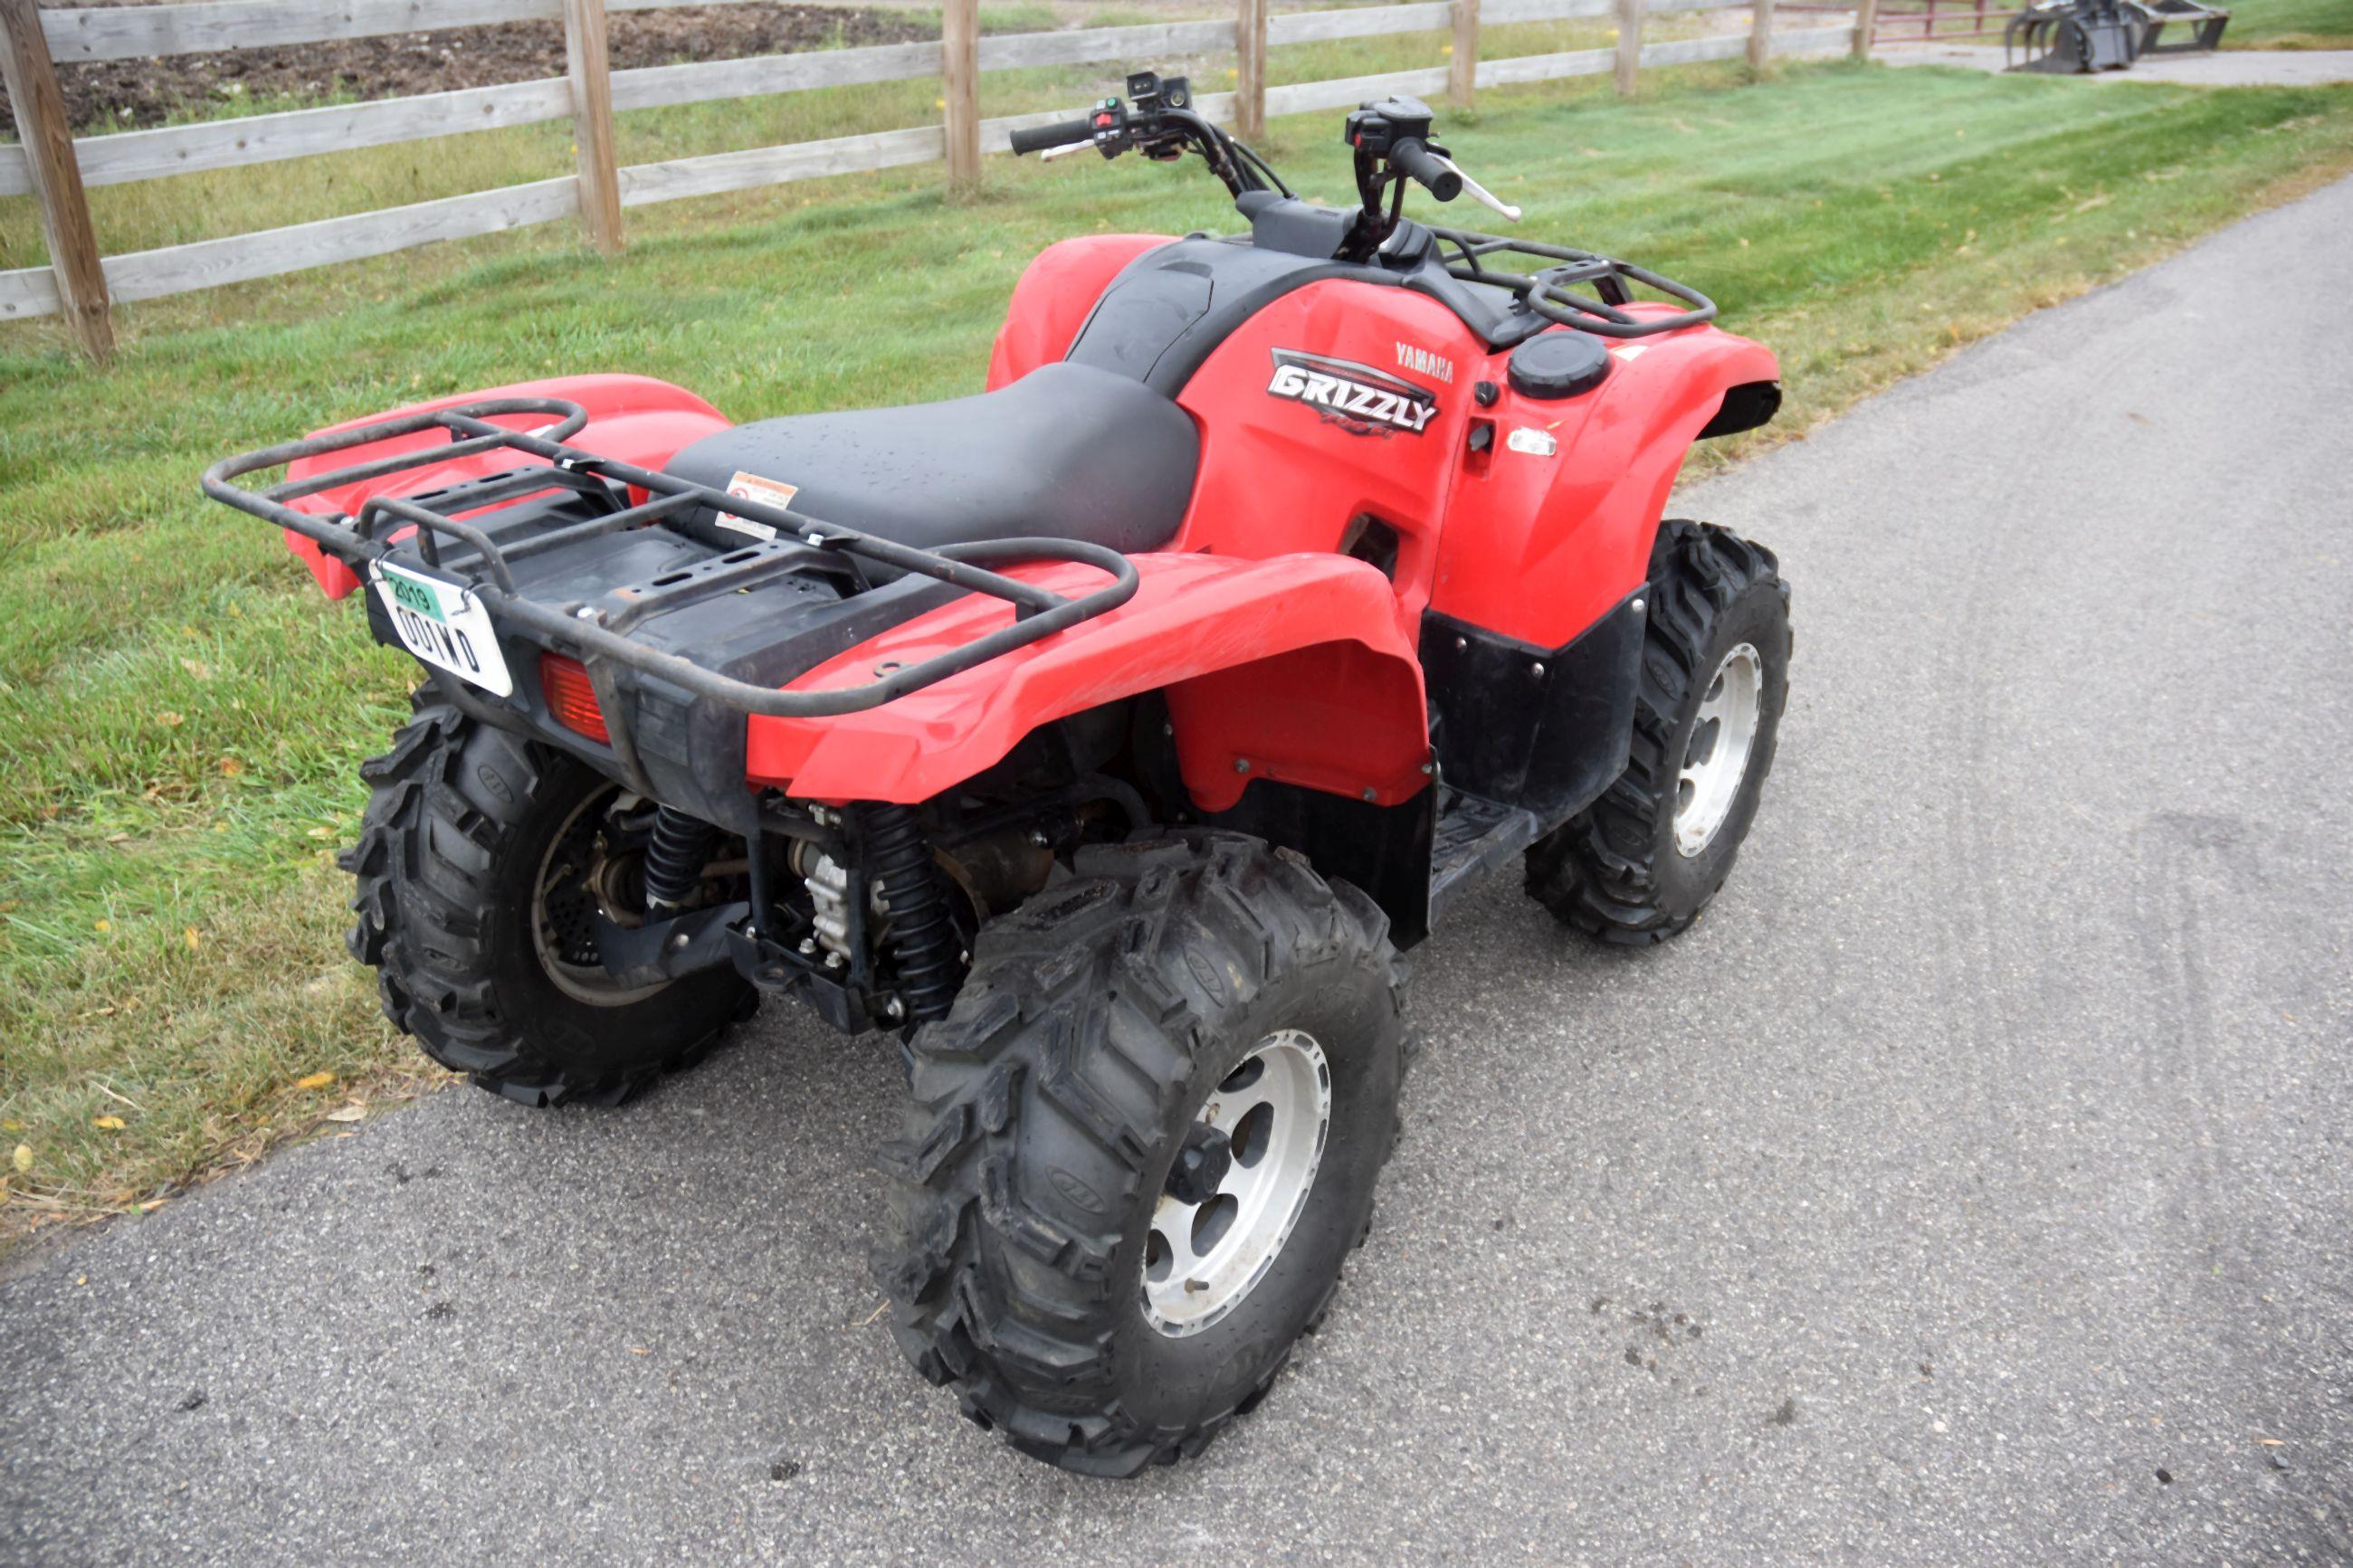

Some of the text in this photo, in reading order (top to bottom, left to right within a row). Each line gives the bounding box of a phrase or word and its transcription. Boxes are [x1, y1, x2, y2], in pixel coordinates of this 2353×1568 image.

[1396, 340, 1453, 385] YAMAHA
[1267, 364, 1438, 432] GRIZZLY
[388, 576, 431, 611] 2019
